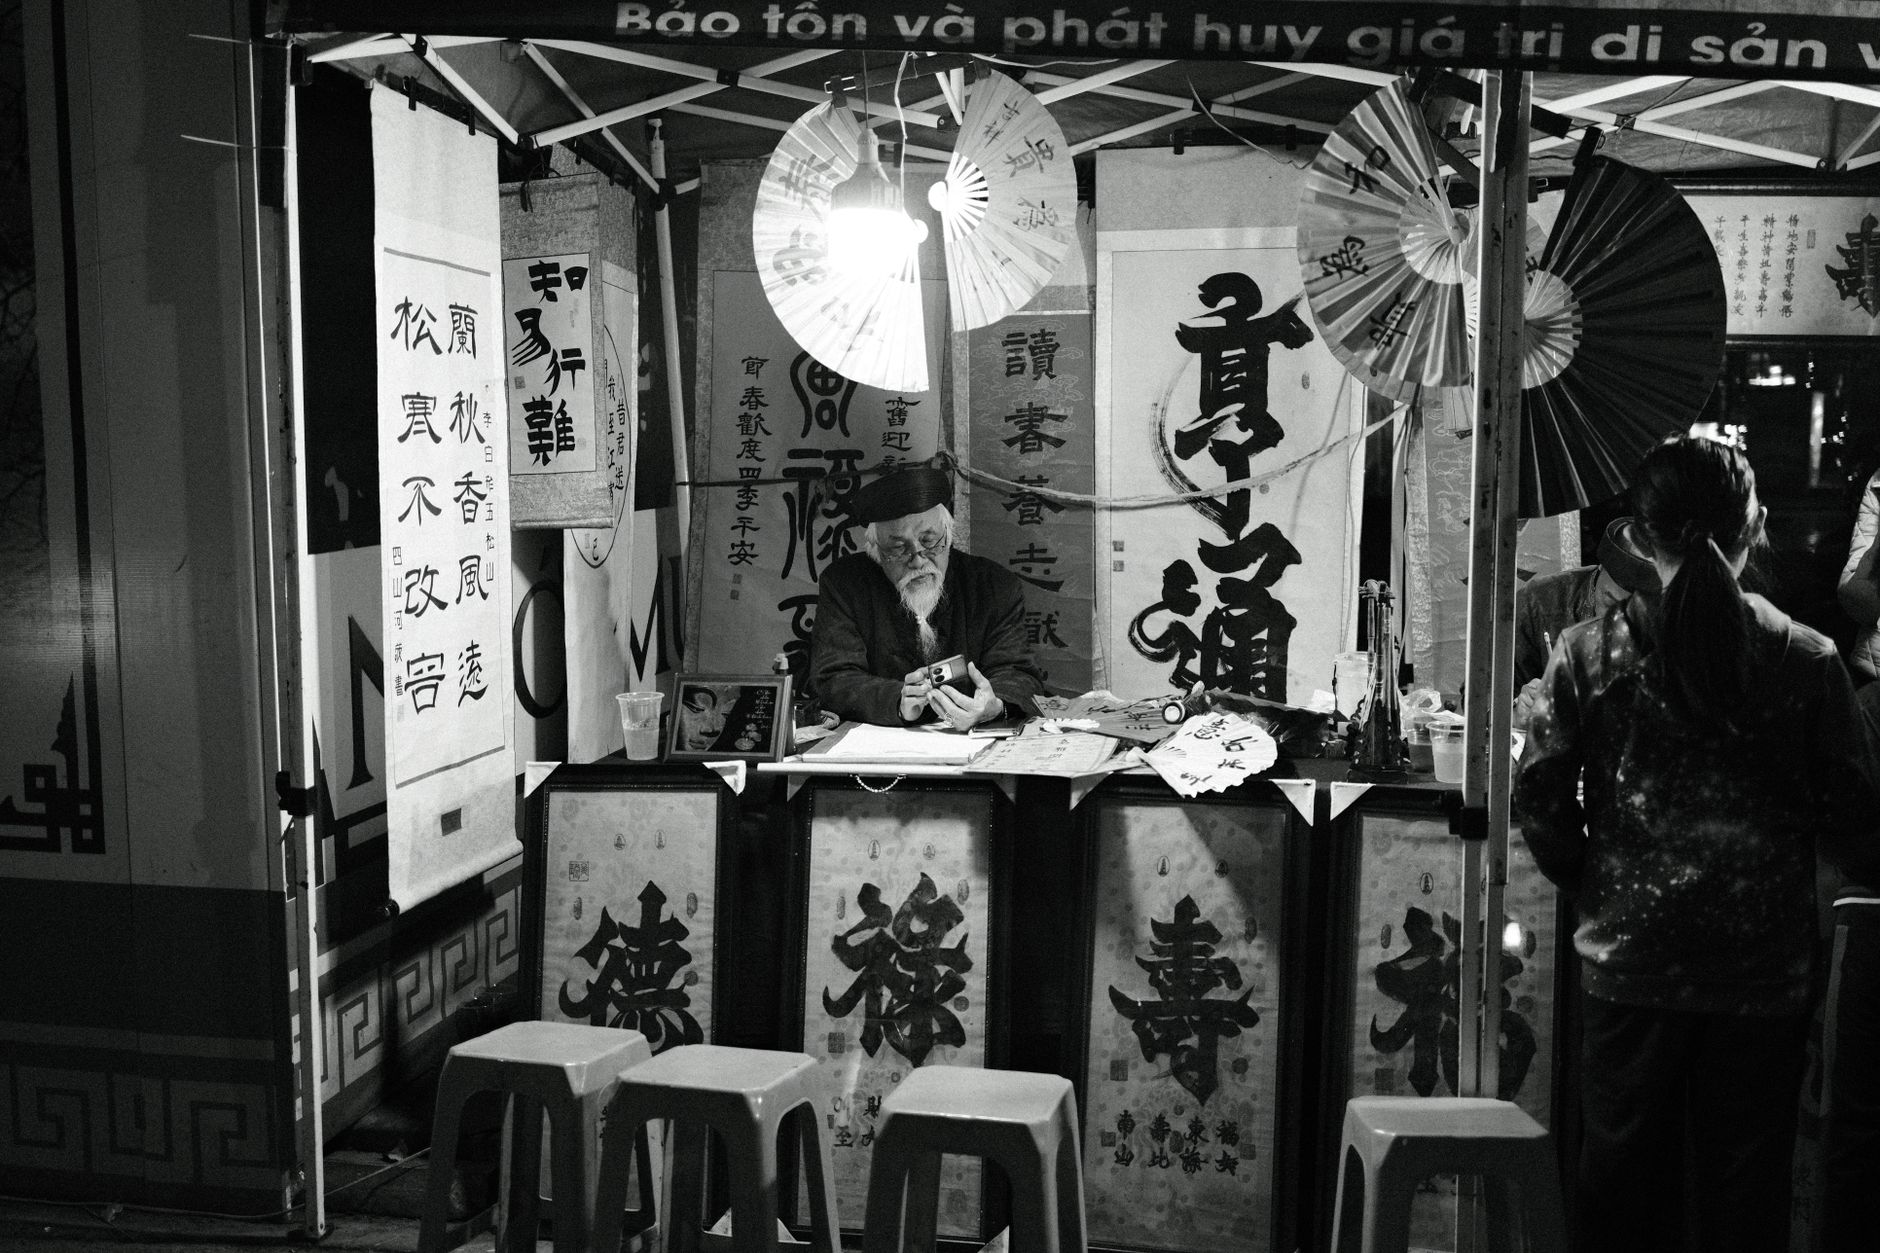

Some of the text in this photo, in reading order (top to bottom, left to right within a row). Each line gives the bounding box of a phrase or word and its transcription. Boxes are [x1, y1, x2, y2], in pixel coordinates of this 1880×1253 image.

[615, 0, 740, 38] Bảo
[893, 2, 975, 44] và
[1003, 6, 1167, 53] phát
[1194, 14, 1322, 62] huy
[1346, 15, 1465, 66] giá
[1590, 25, 1663, 62] di
[1689, 22, 1827, 69] sản
[390, 296, 448, 714] 松寒不改容
[448, 302, 488, 708] 蘭秋香風遠
[1109, 894, 1260, 1107] 壽
